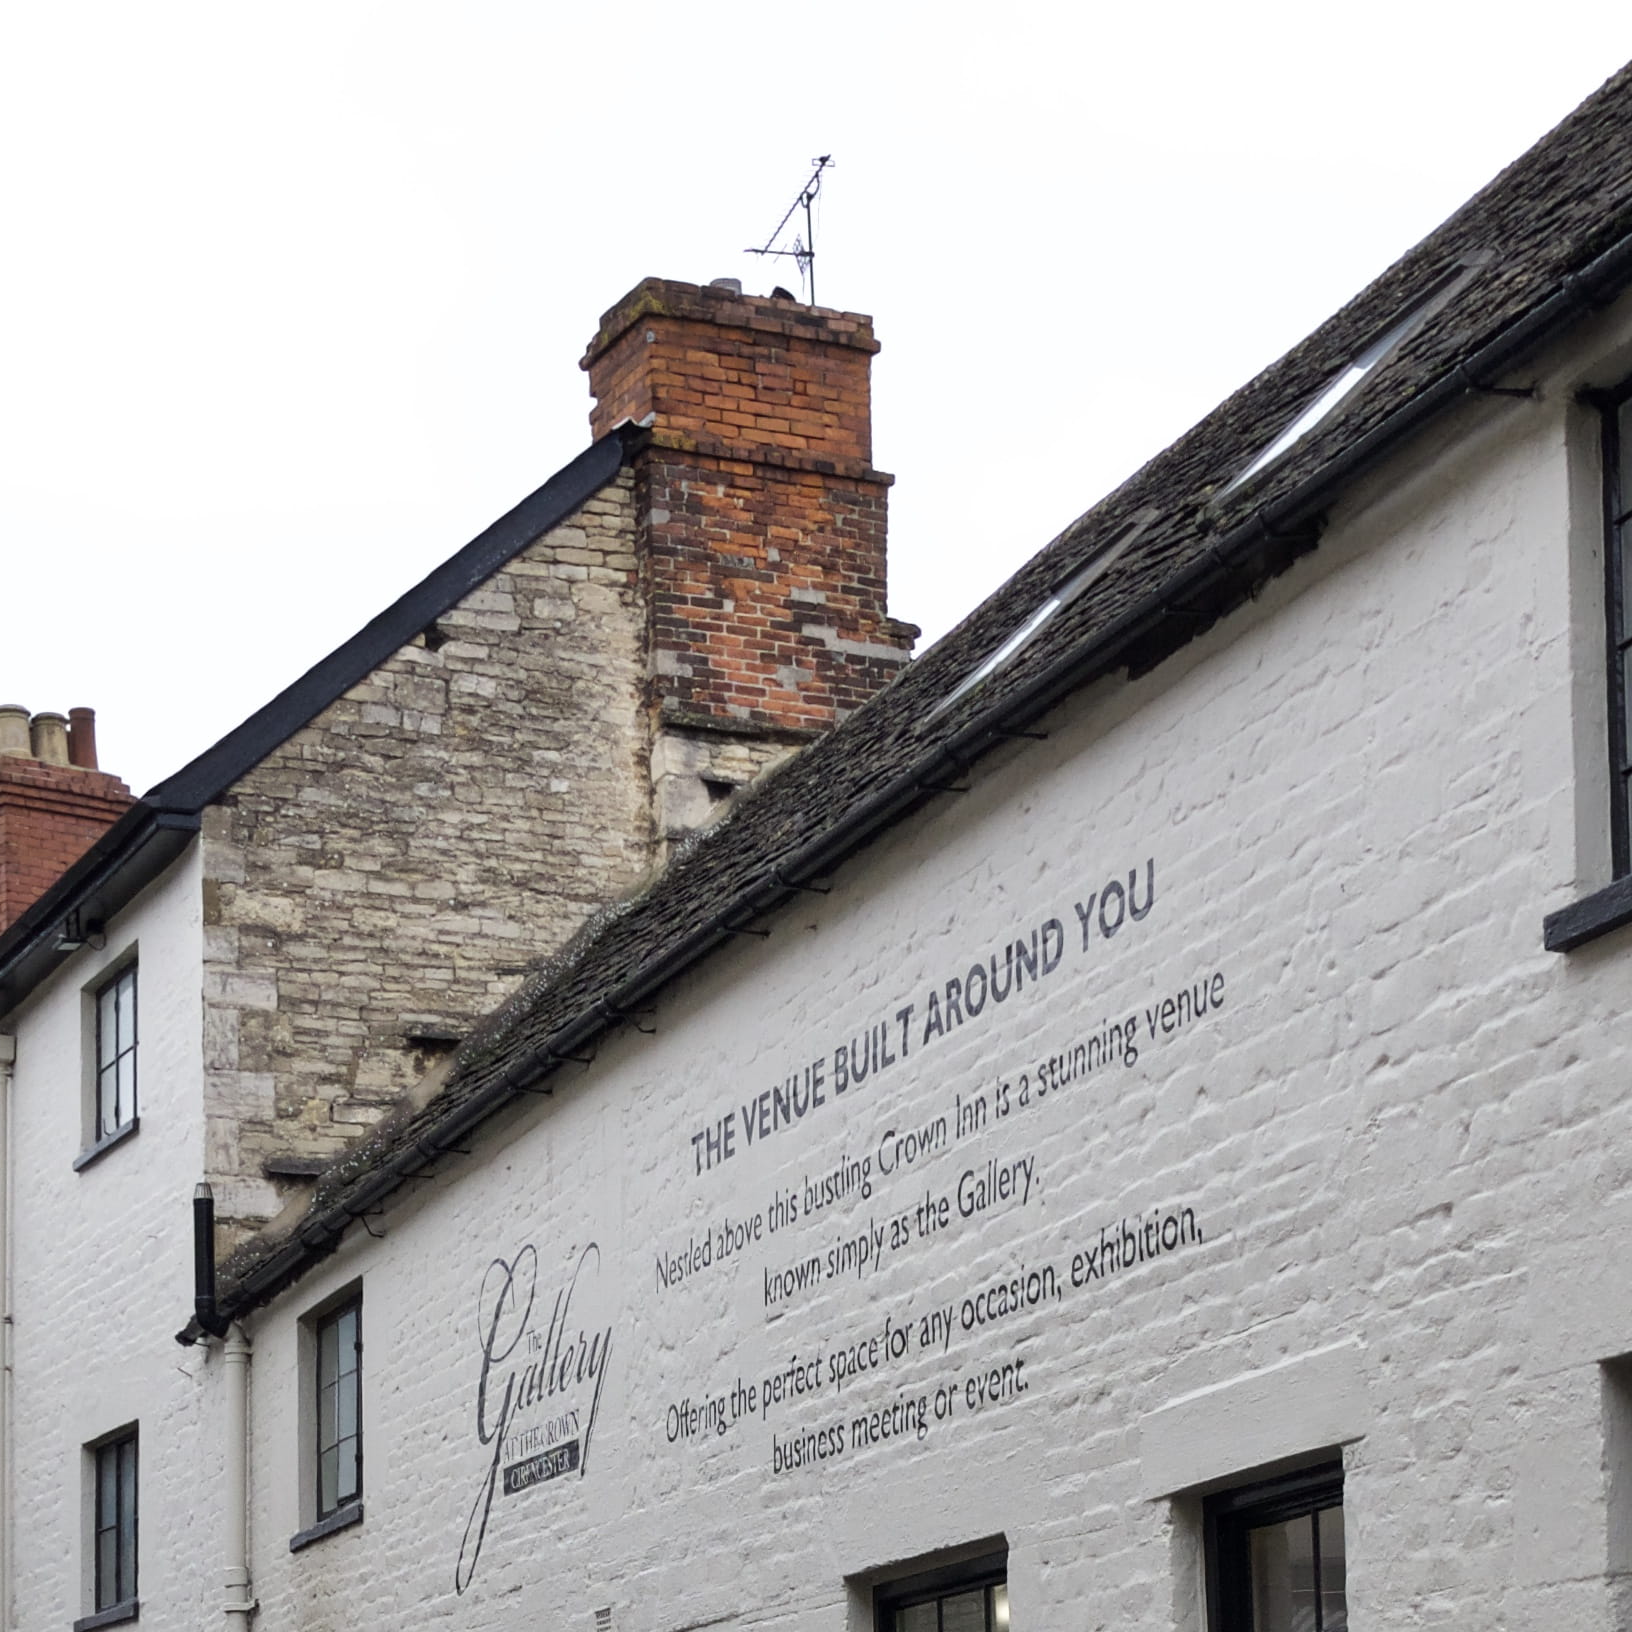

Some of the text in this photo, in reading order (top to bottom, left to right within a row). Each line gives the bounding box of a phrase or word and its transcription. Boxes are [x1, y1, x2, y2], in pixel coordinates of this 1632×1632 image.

[655, 971, 1226, 1294] Nestled above this bustling Crown Inn is a stunning venue
[691, 857, 1154, 1176] THE VENUE BUILT AROUND YOU
[526, 1330, 543, 1354] The
[667, 1207, 1203, 1442] Offering the perfect space for any occasion, exhibition,
[764, 1154, 1041, 1307] known simply as the Gallery.
[456, 1242, 614, 1596] Gallery
[773, 1358, 1029, 1475] business meeting or event.
